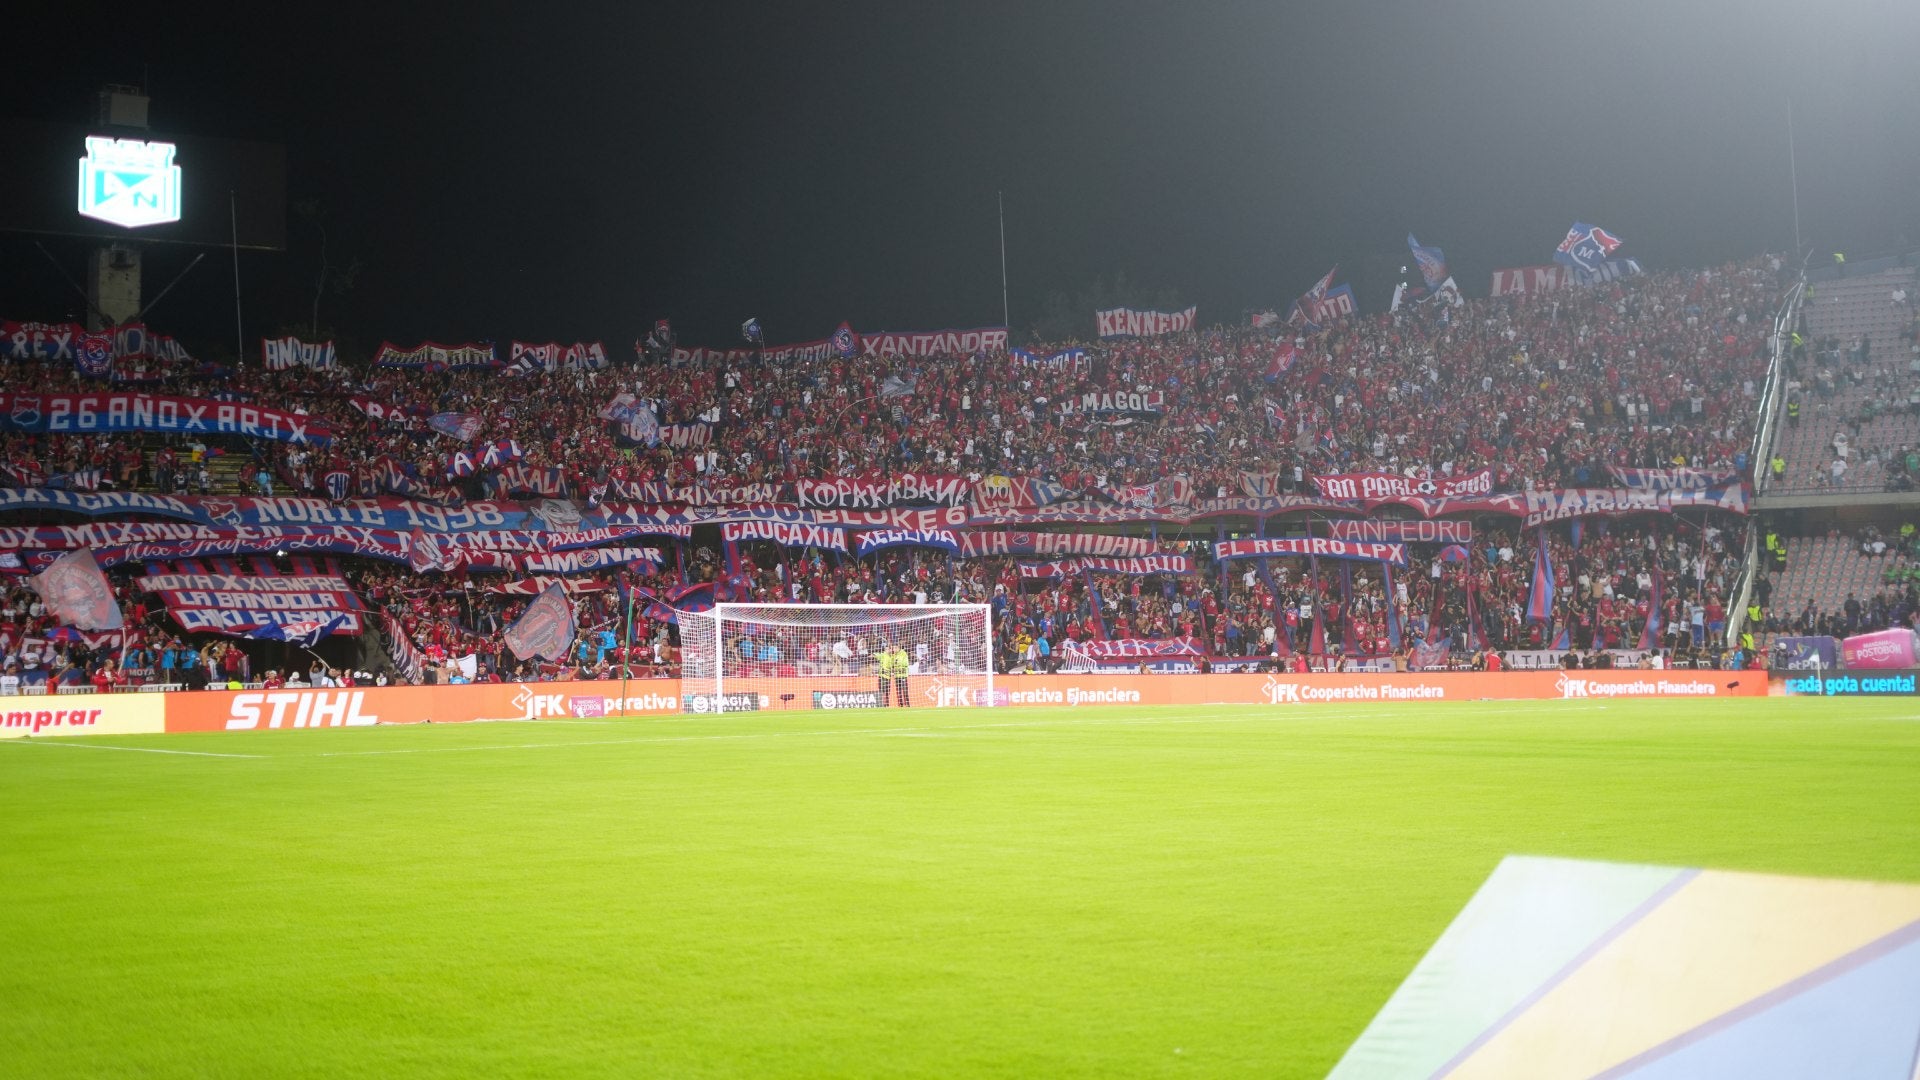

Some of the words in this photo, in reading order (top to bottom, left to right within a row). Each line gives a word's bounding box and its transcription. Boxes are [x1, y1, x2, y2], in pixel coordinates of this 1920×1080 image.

[1096, 306, 1198, 337] KENNEDY
[11, 331, 74, 360] REX
[861, 331, 1007, 356] XANTANDER
[50, 399, 98, 430] 26
[251, 497, 387, 526] NORTE
[725, 522, 847, 551] CAUCAXIA
[1328, 520, 1472, 543] XANPEDRO
[1213, 542, 1246, 560] EL
[1255, 538, 1347, 555] RETIRO
[1356, 542, 1405, 564] LPX
[174, 591, 211, 608] LA
[215, 591, 340, 609] BANDOLA
[1301, 684, 1378, 701] Cooperativa
[1380, 684, 1445, 699] Financiera
[1588, 680, 1656, 697] Cooperativa
[1656, 680, 1717, 695] Financiera
[1823, 676, 1858, 696] gota
[1859, 675, 1916, 692] cuenta!
[225, 691, 378, 731] STIHL
[569, 694, 677, 715] perativa
[0, 710, 102, 733] mprar
